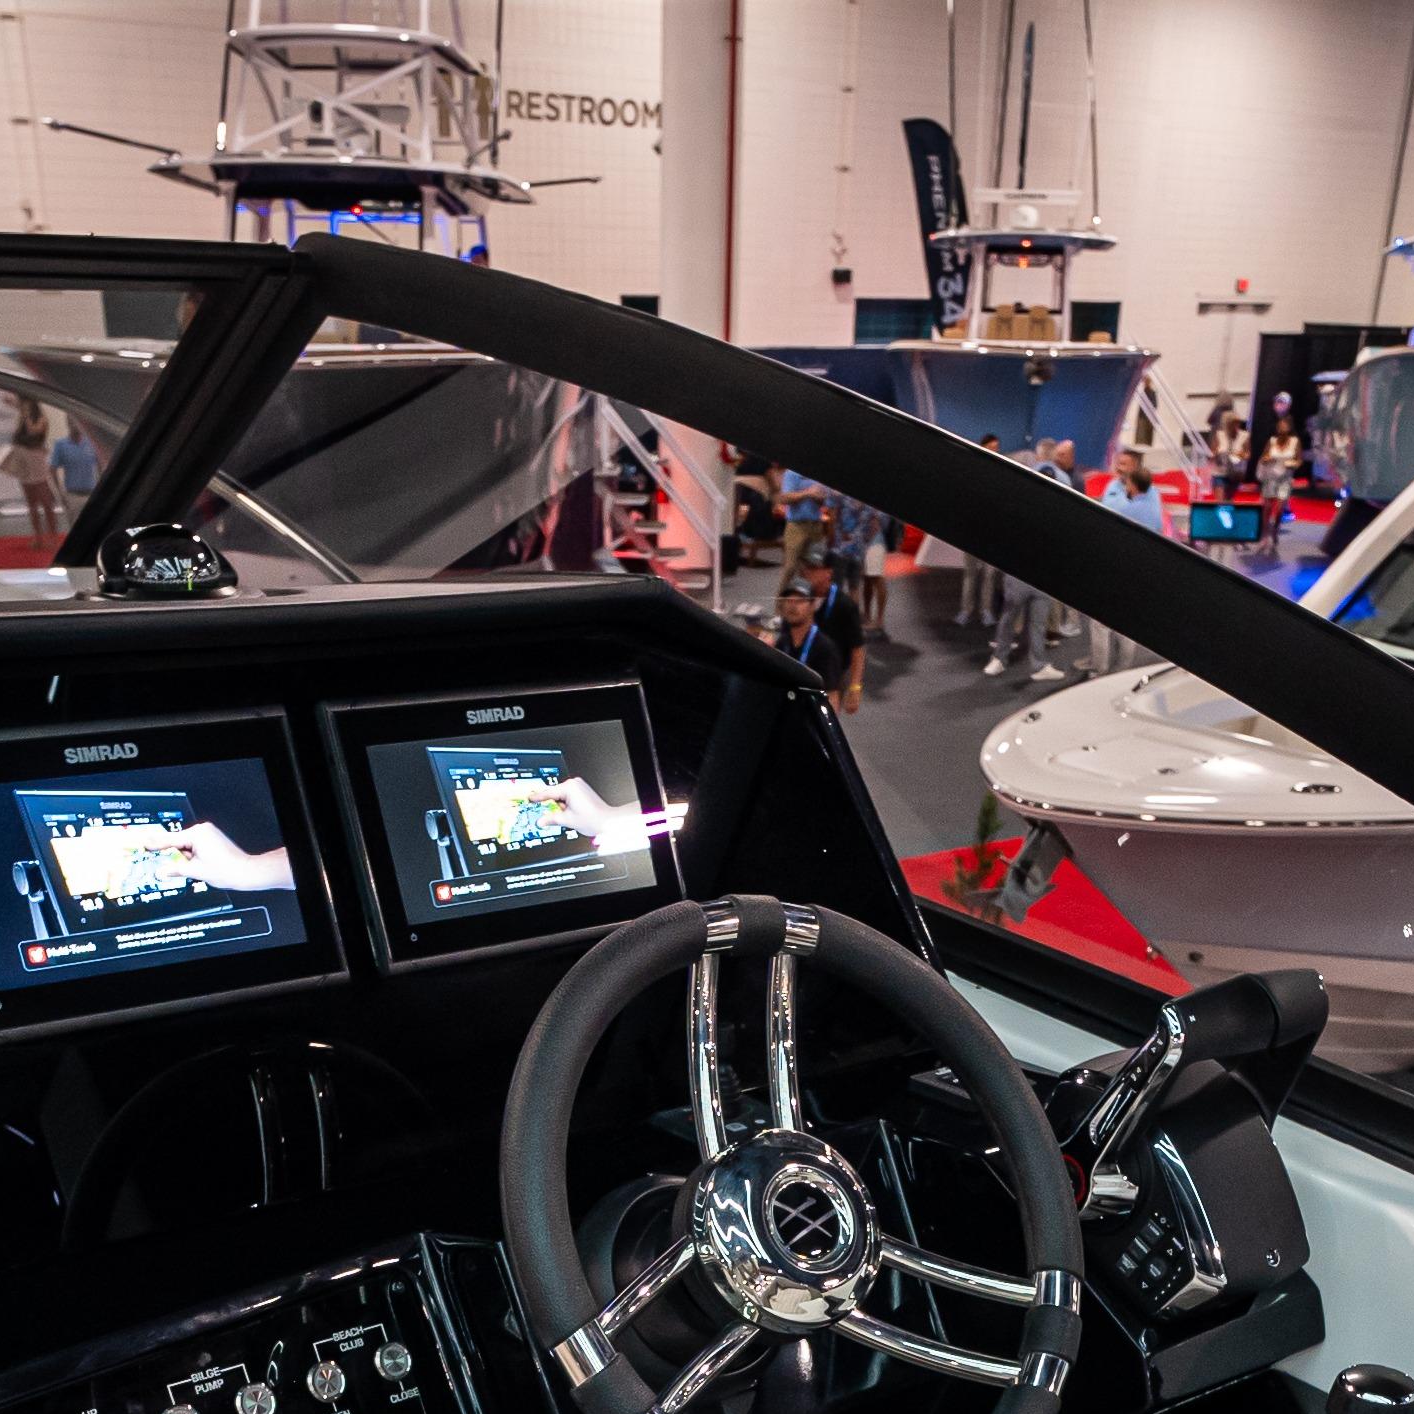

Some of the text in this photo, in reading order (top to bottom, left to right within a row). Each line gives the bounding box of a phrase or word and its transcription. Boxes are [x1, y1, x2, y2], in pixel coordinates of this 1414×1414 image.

[505, 89, 663, 129] RESTROOM
[466, 705, 525, 726] SIMRAD
[64, 742, 140, 765] SIMRAD
[332, 1326, 364, 1342] BEACH
[339, 1338, 365, 1352] CLUB
[190, 1366, 222, 1383] BILGE
[194, 1378, 225, 1395] PUMP
[389, 1387, 420, 1404] CLOSE
